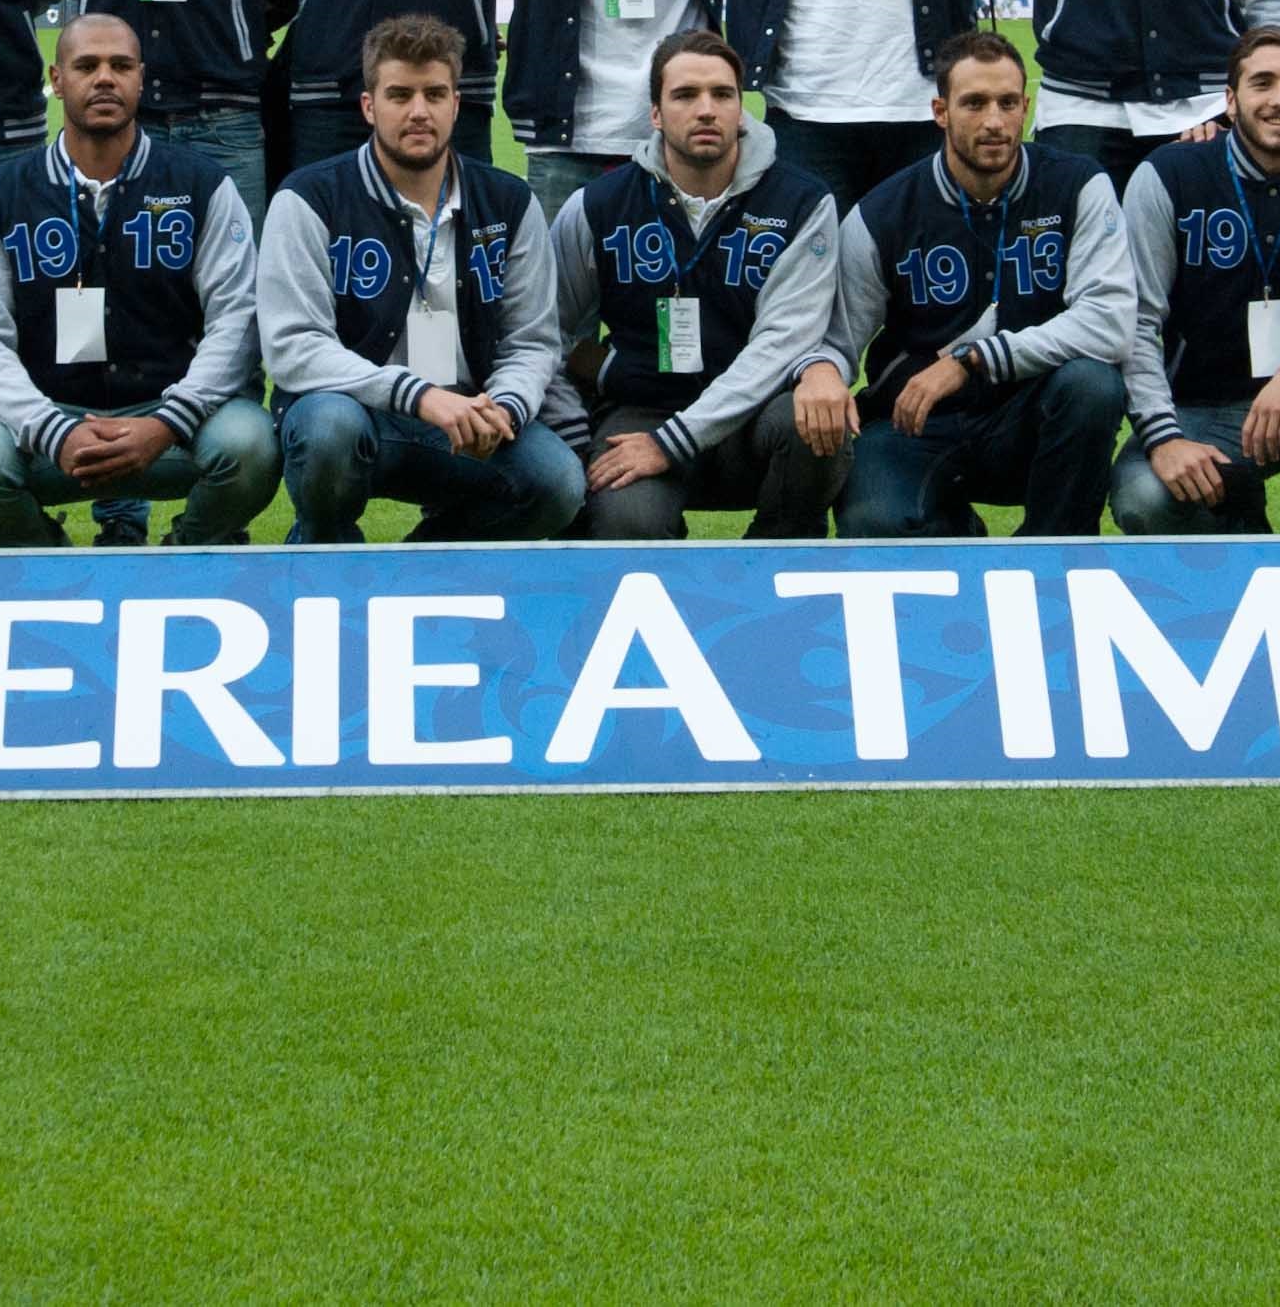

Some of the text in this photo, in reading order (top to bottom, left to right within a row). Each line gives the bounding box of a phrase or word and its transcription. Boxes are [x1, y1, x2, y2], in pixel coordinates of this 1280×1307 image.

[2, 210, 195, 283] 19 13
[330, 235, 507, 304] 19 13
[602, 222, 786, 291] 19 13
[895, 232, 1065, 305] 19 13
[1178, 208, 1249, 271] 19
[544, 570, 763, 767] A
